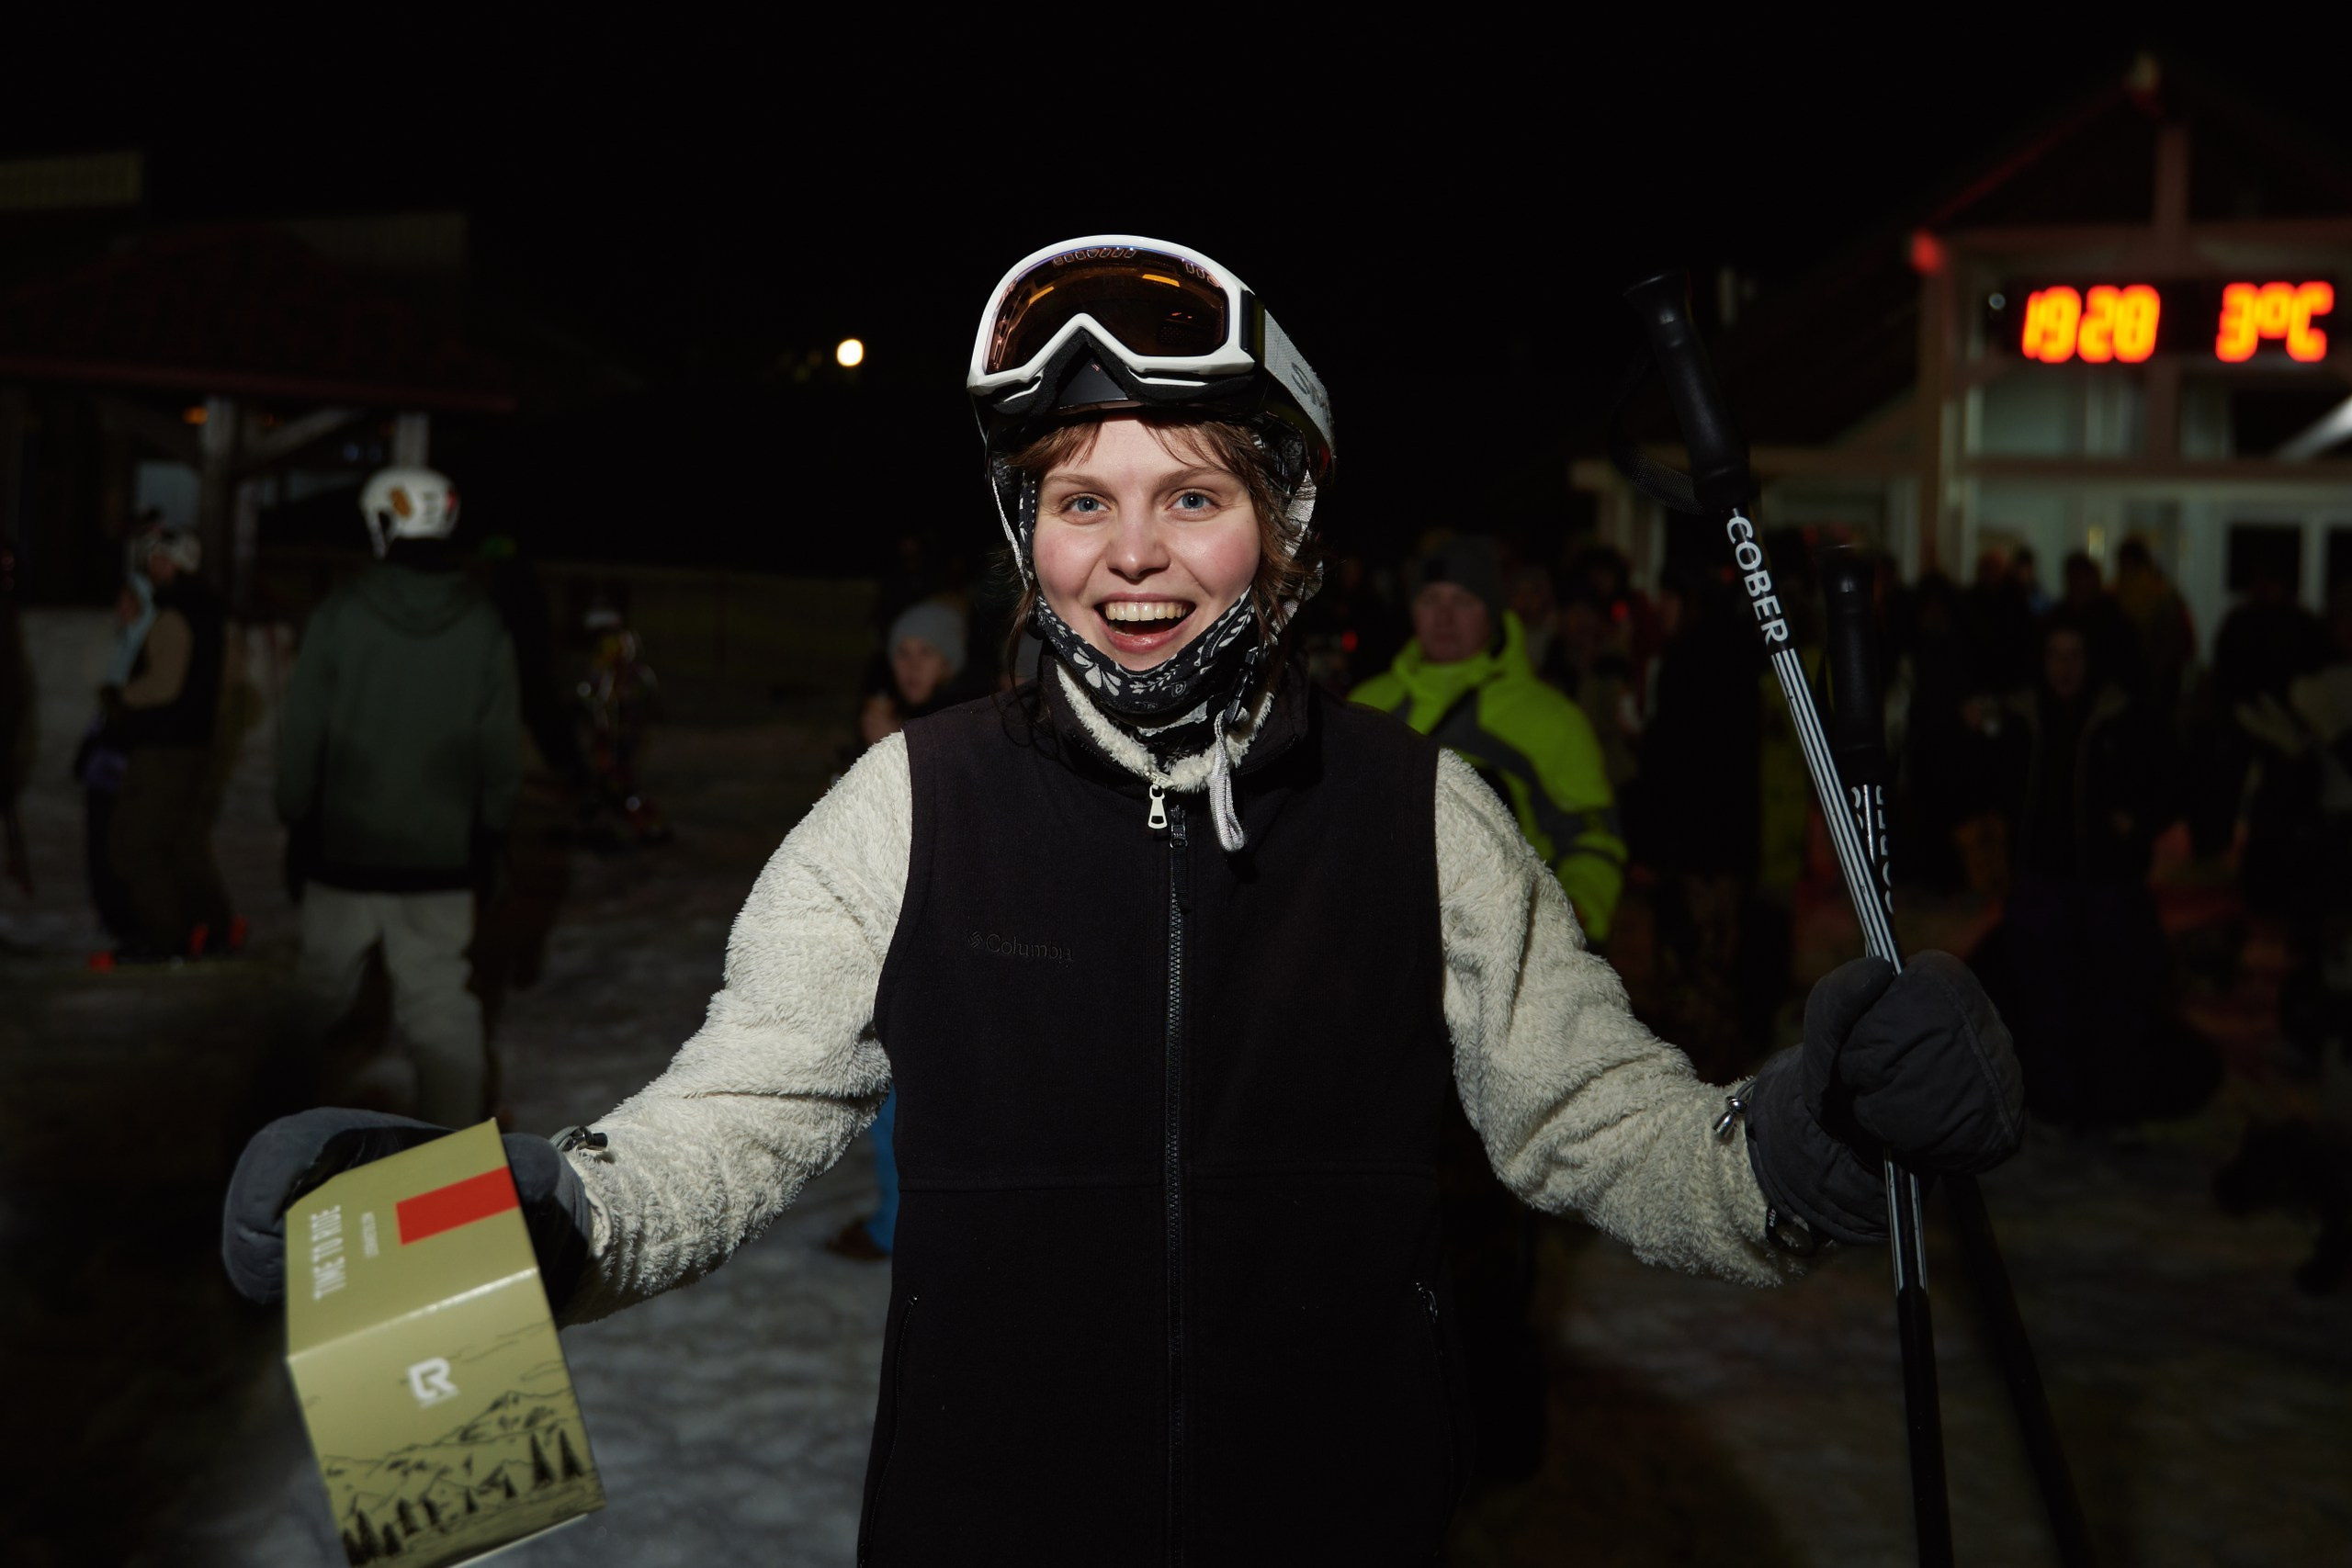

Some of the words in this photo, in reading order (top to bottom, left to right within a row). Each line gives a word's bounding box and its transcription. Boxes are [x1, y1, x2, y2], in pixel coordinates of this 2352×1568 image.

[1726, 515, 1790, 646] COBER
[986, 933, 1073, 961] Columbia
[311, 1204, 341, 1243] RIDE
[311, 1237, 344, 1264] TO
